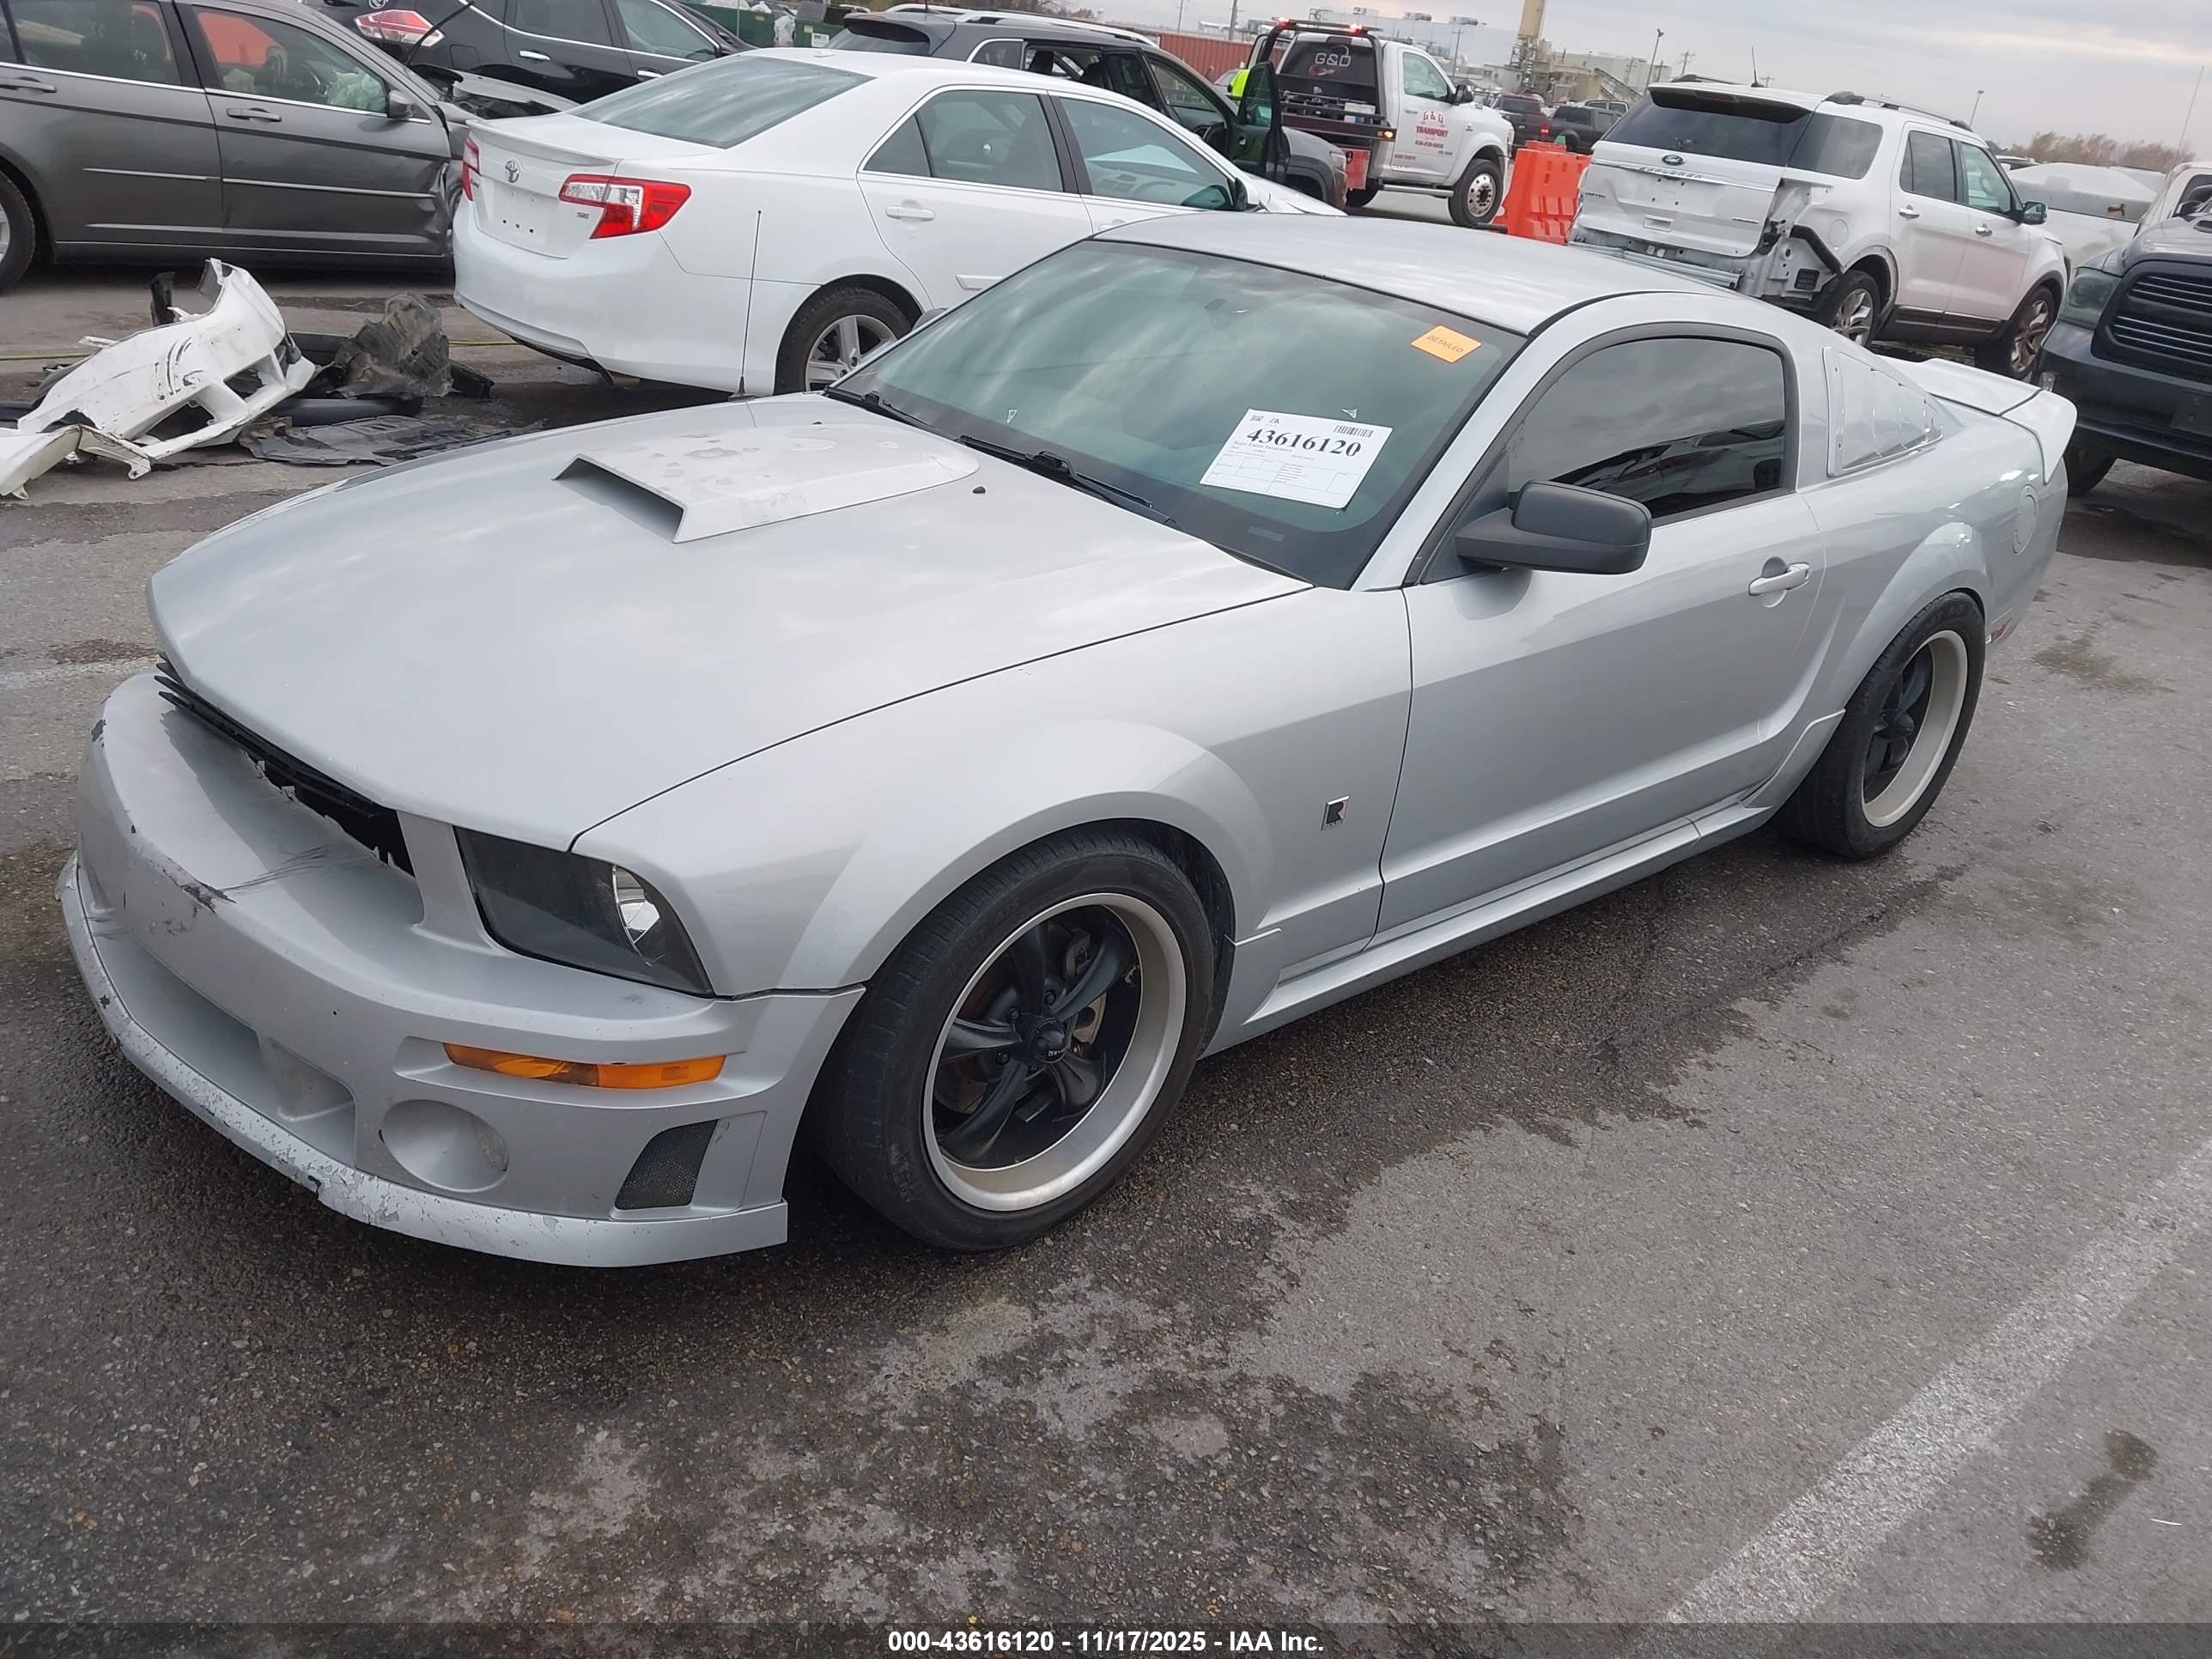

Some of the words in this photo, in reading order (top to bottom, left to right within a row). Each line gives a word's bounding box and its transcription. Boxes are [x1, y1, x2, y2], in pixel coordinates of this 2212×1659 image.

[1315, 52, 1351, 67] G&D
[1417, 125, 1449, 137] TRANSPORT
[1426, 335, 1464, 354] DETAILED
[1246, 428, 1362, 458] 43616120
